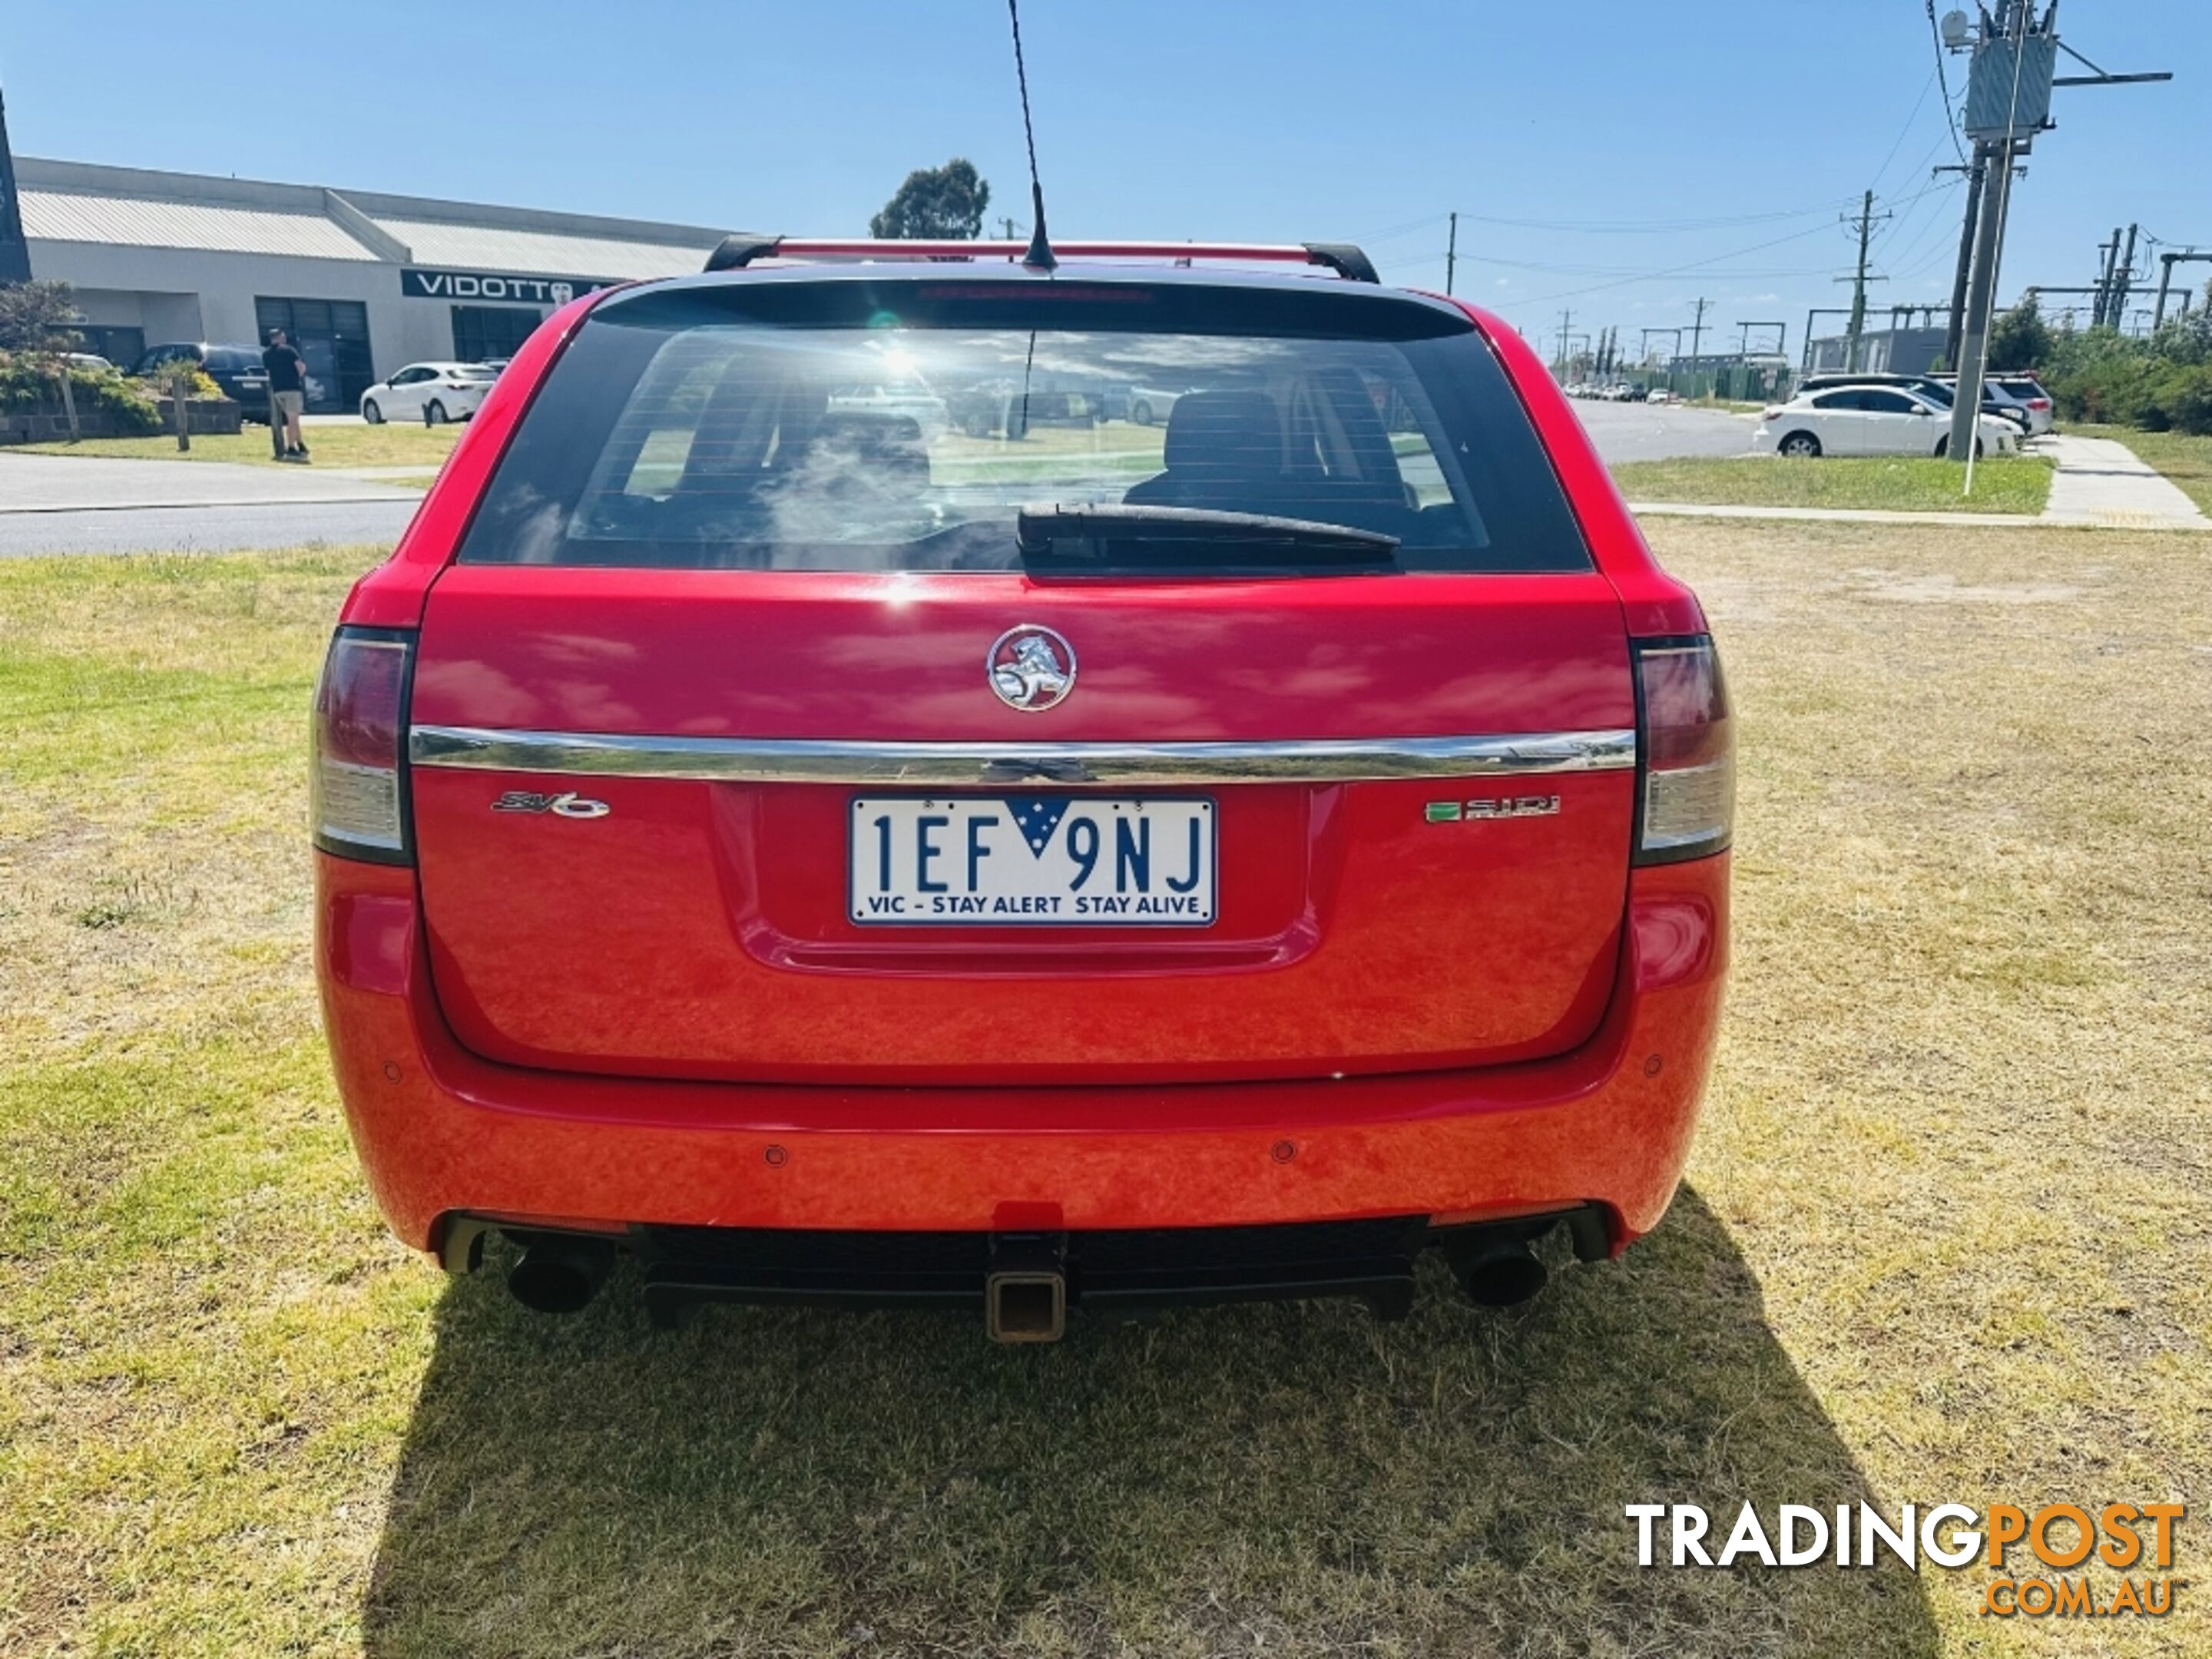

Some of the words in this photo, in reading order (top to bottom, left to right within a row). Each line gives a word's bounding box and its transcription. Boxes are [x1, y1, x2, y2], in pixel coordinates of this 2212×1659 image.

[491, 791, 611, 818] SV6
[868, 896, 906, 913] VIC
[932, 896, 988, 913] STAY
[992, 896, 1061, 913] ALERT
[1076, 896, 1130, 913] STAY
[1135, 896, 1200, 913] ALIVE
